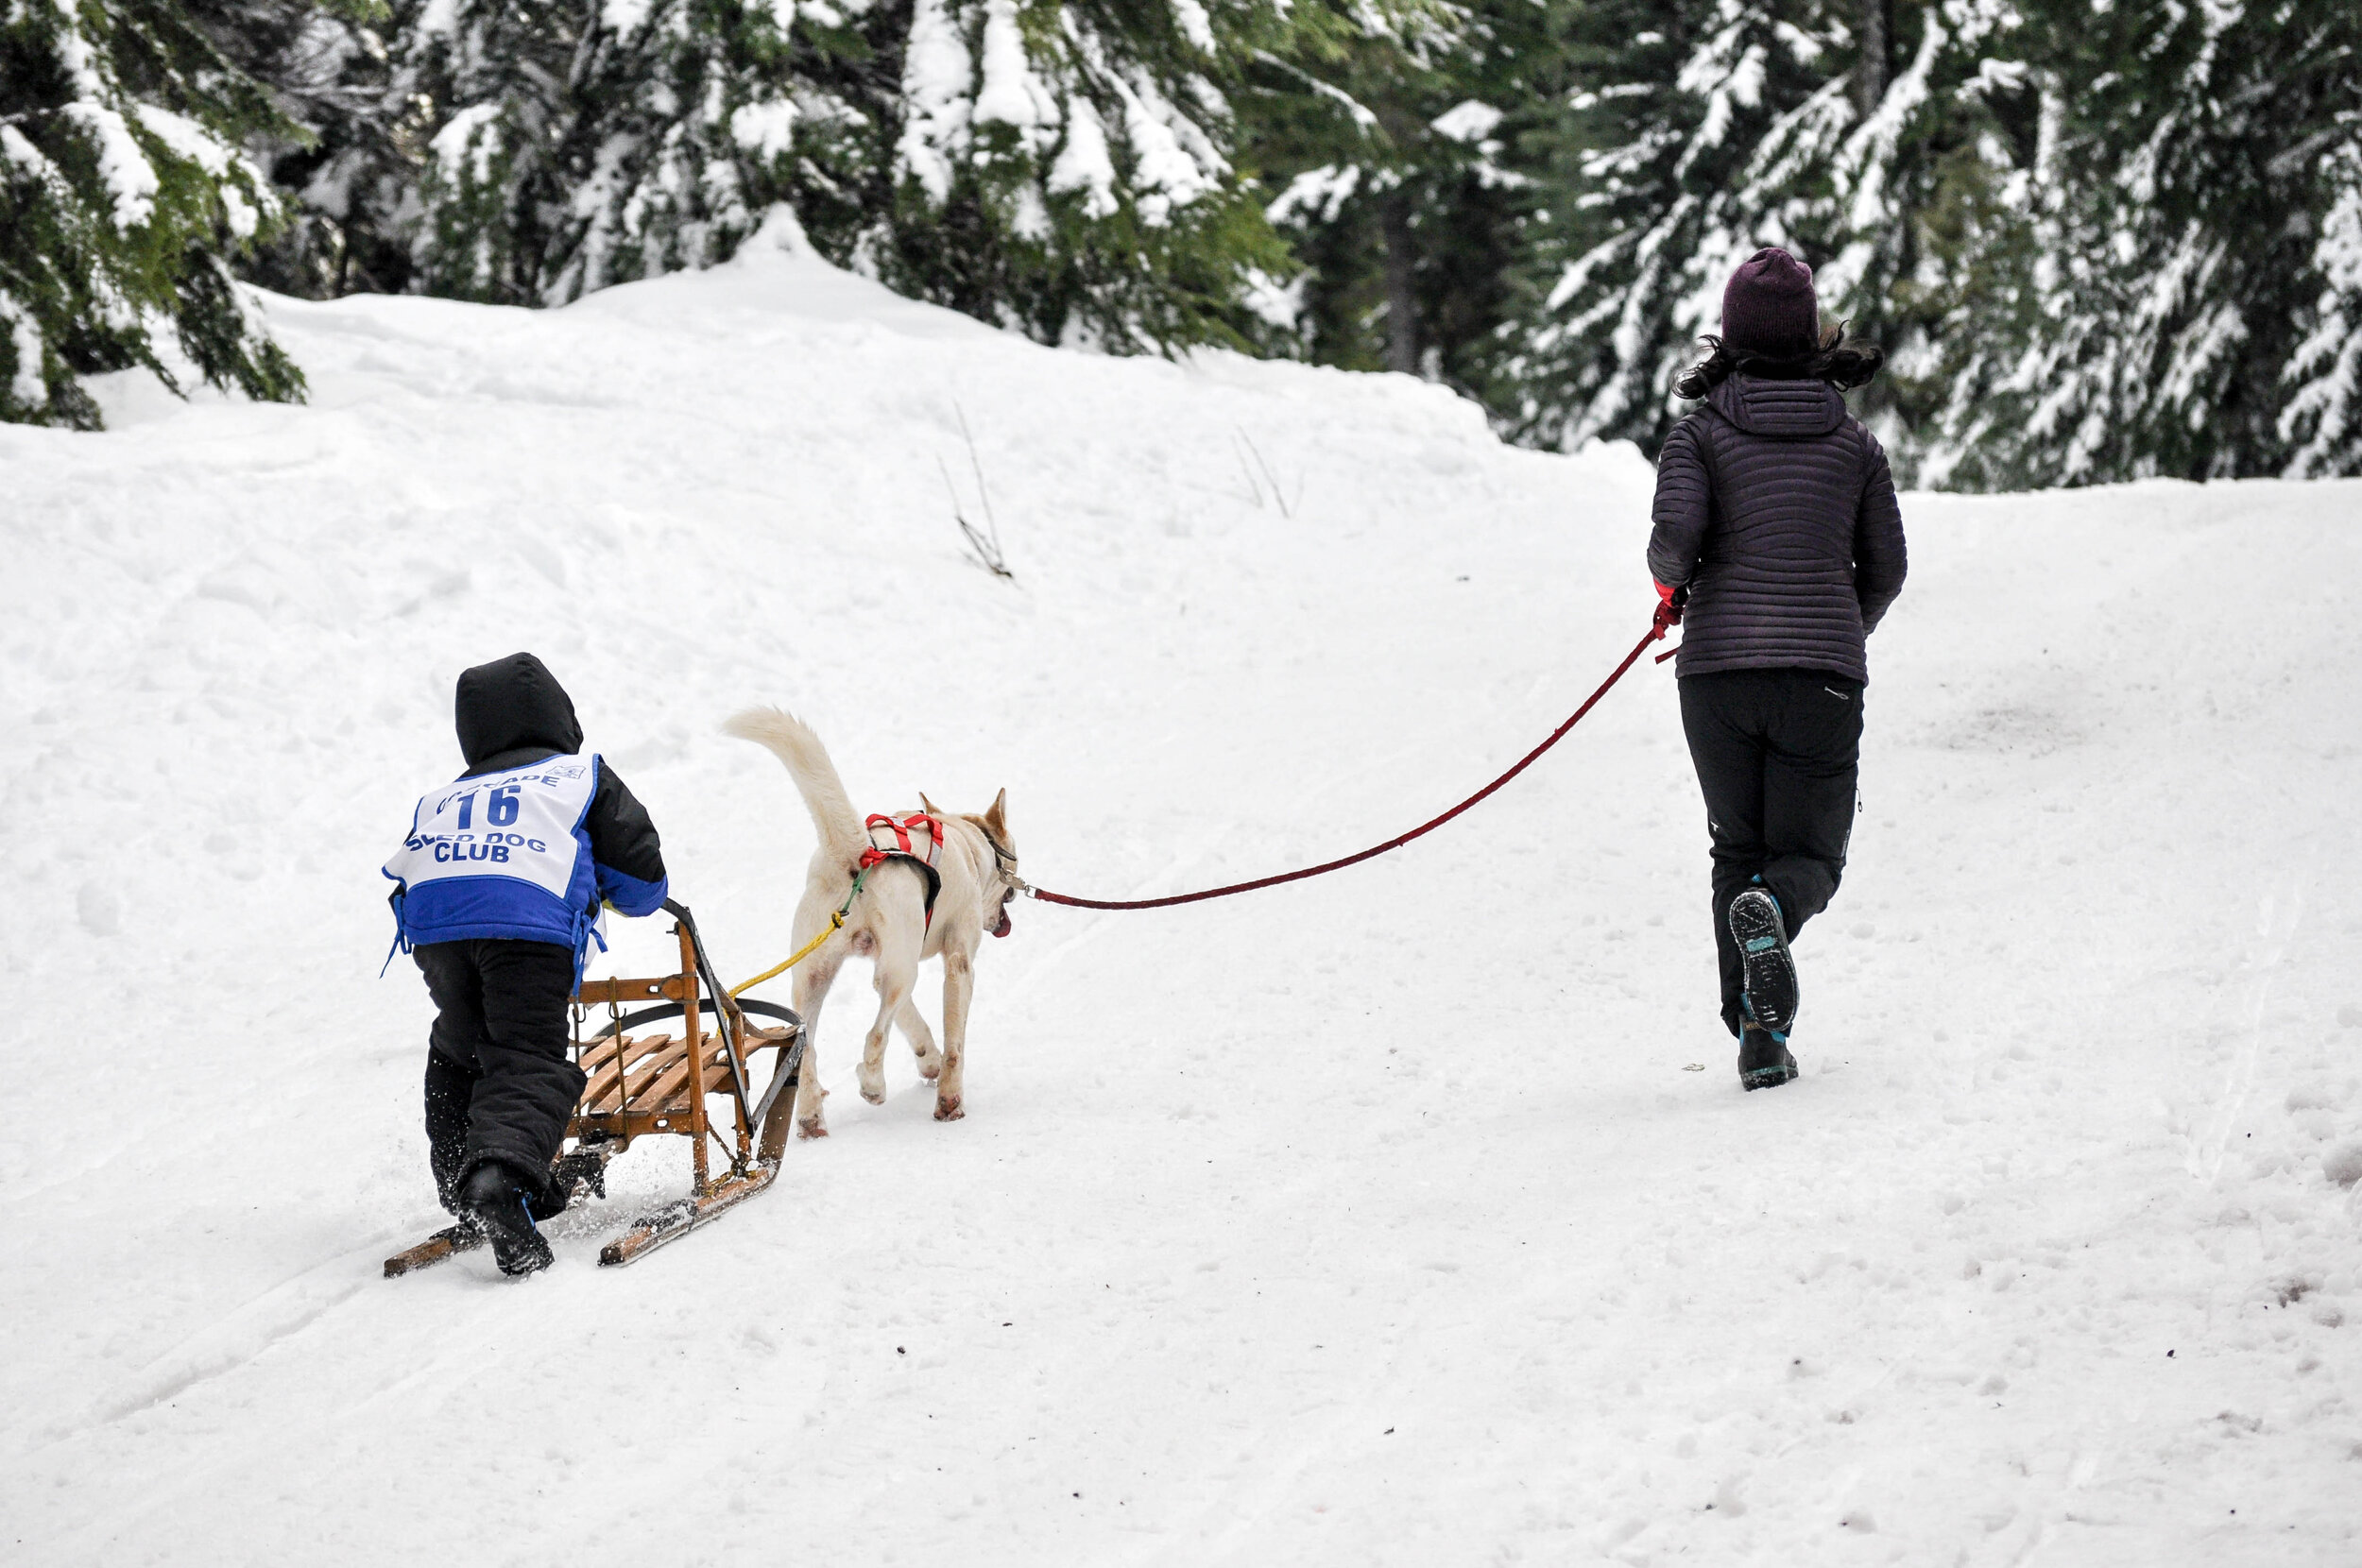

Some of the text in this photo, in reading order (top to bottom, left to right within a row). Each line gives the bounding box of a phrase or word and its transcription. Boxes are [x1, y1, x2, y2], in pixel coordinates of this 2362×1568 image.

[456, 785, 522, 830] 16
[434, 843, 510, 863] CLUB
[485, 832, 547, 853] DOG
